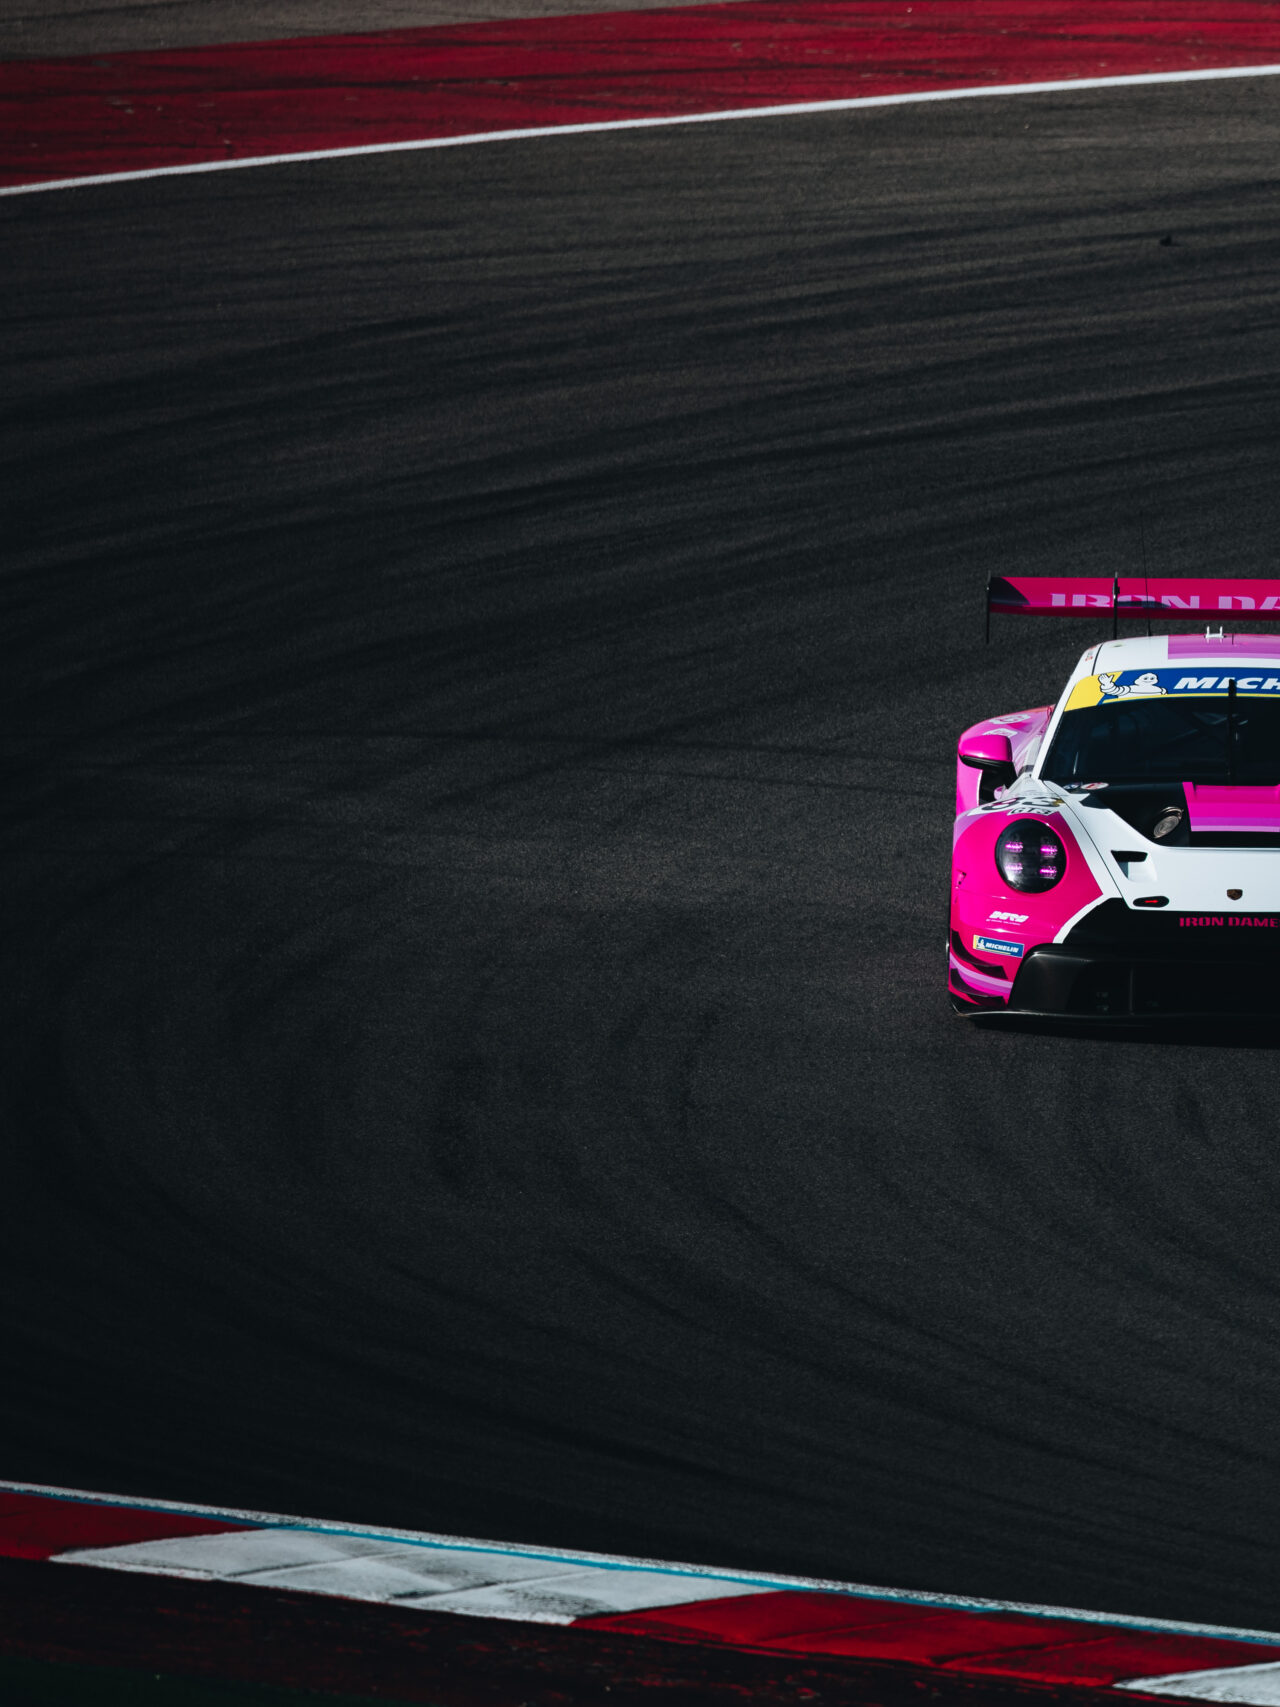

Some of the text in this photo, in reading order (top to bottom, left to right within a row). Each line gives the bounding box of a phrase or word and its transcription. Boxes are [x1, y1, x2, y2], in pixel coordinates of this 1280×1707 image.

[1050, 593, 1200, 609] IRON
[1179, 917, 1224, 928] IRON
[985, 942, 1020, 953] MICHELIN
